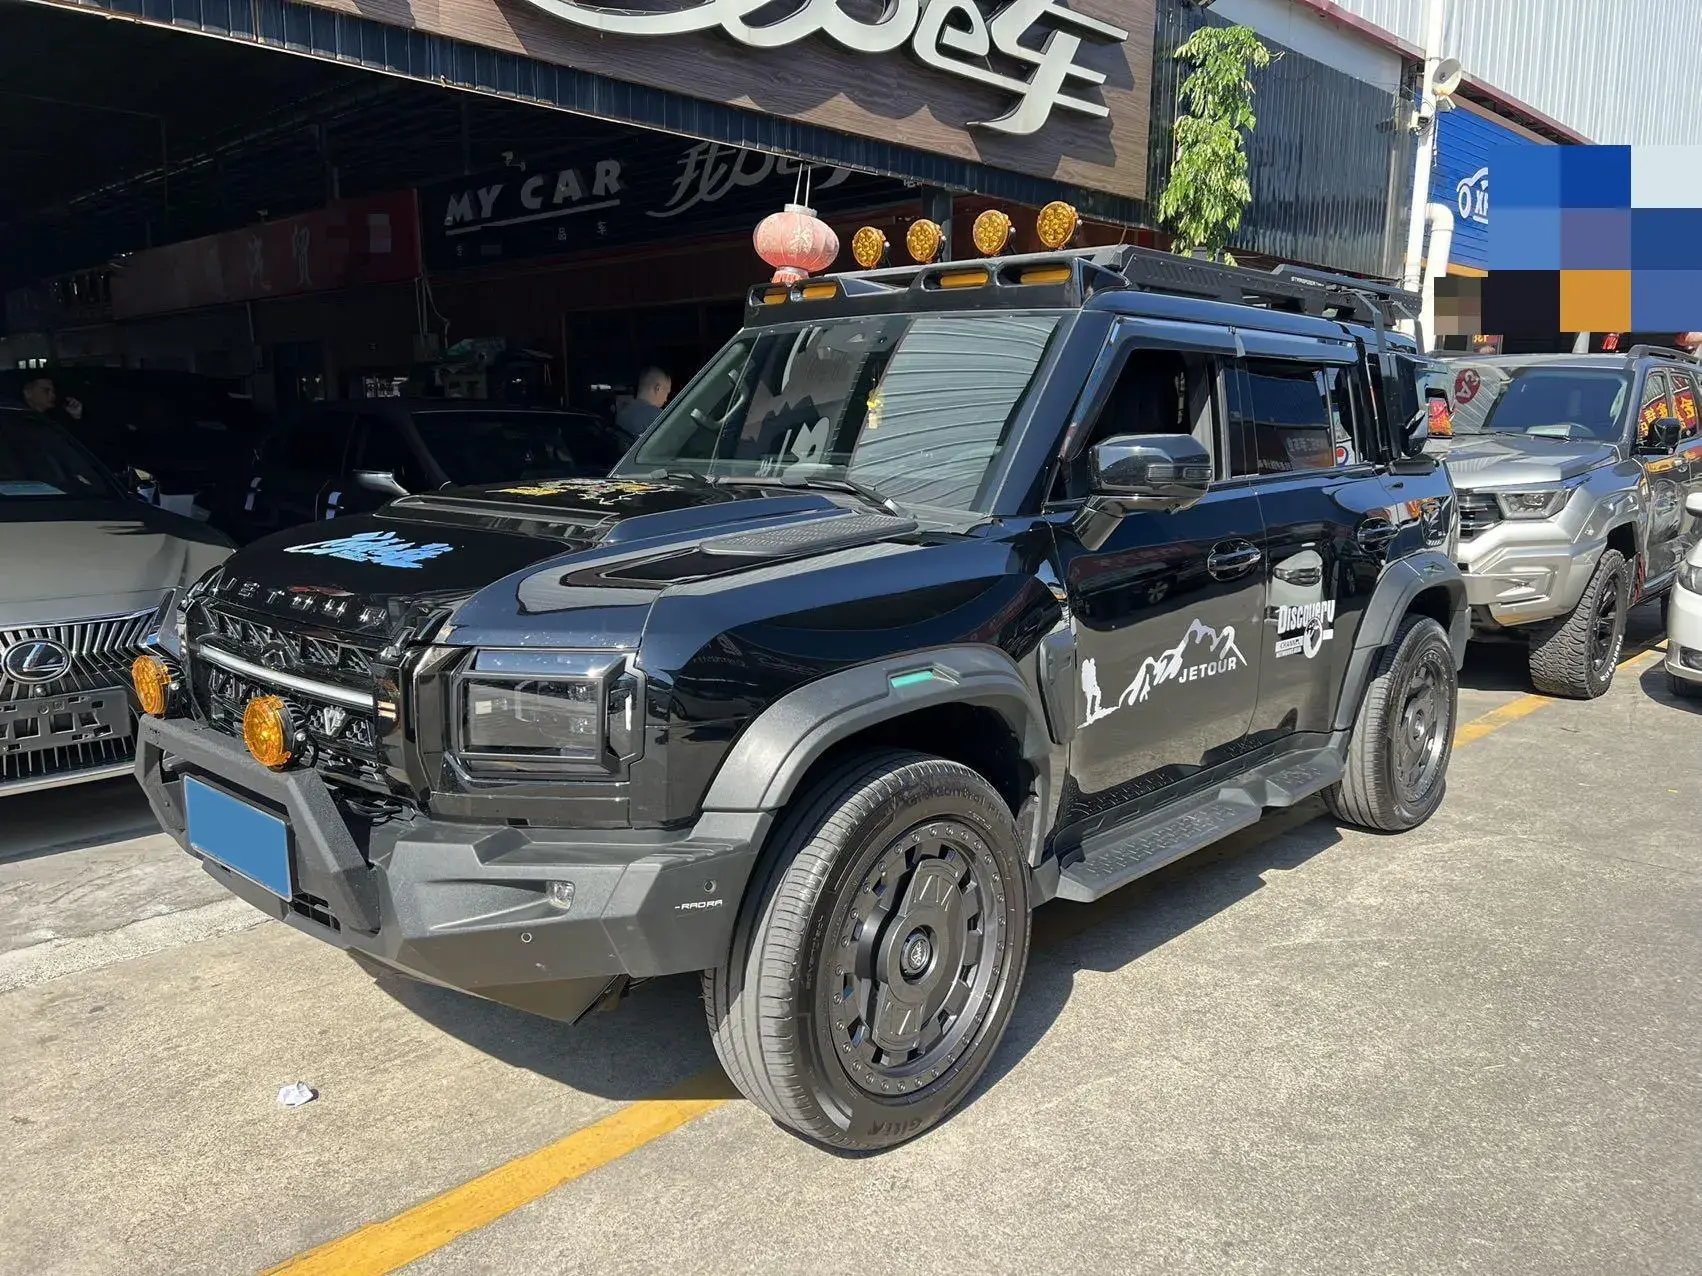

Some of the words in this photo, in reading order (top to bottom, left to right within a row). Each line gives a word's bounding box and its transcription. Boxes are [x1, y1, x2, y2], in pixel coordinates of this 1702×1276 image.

[445, 183, 503, 226] MY
[520, 159, 624, 210] CAR
[1178, 656, 1237, 684] JETOUR
